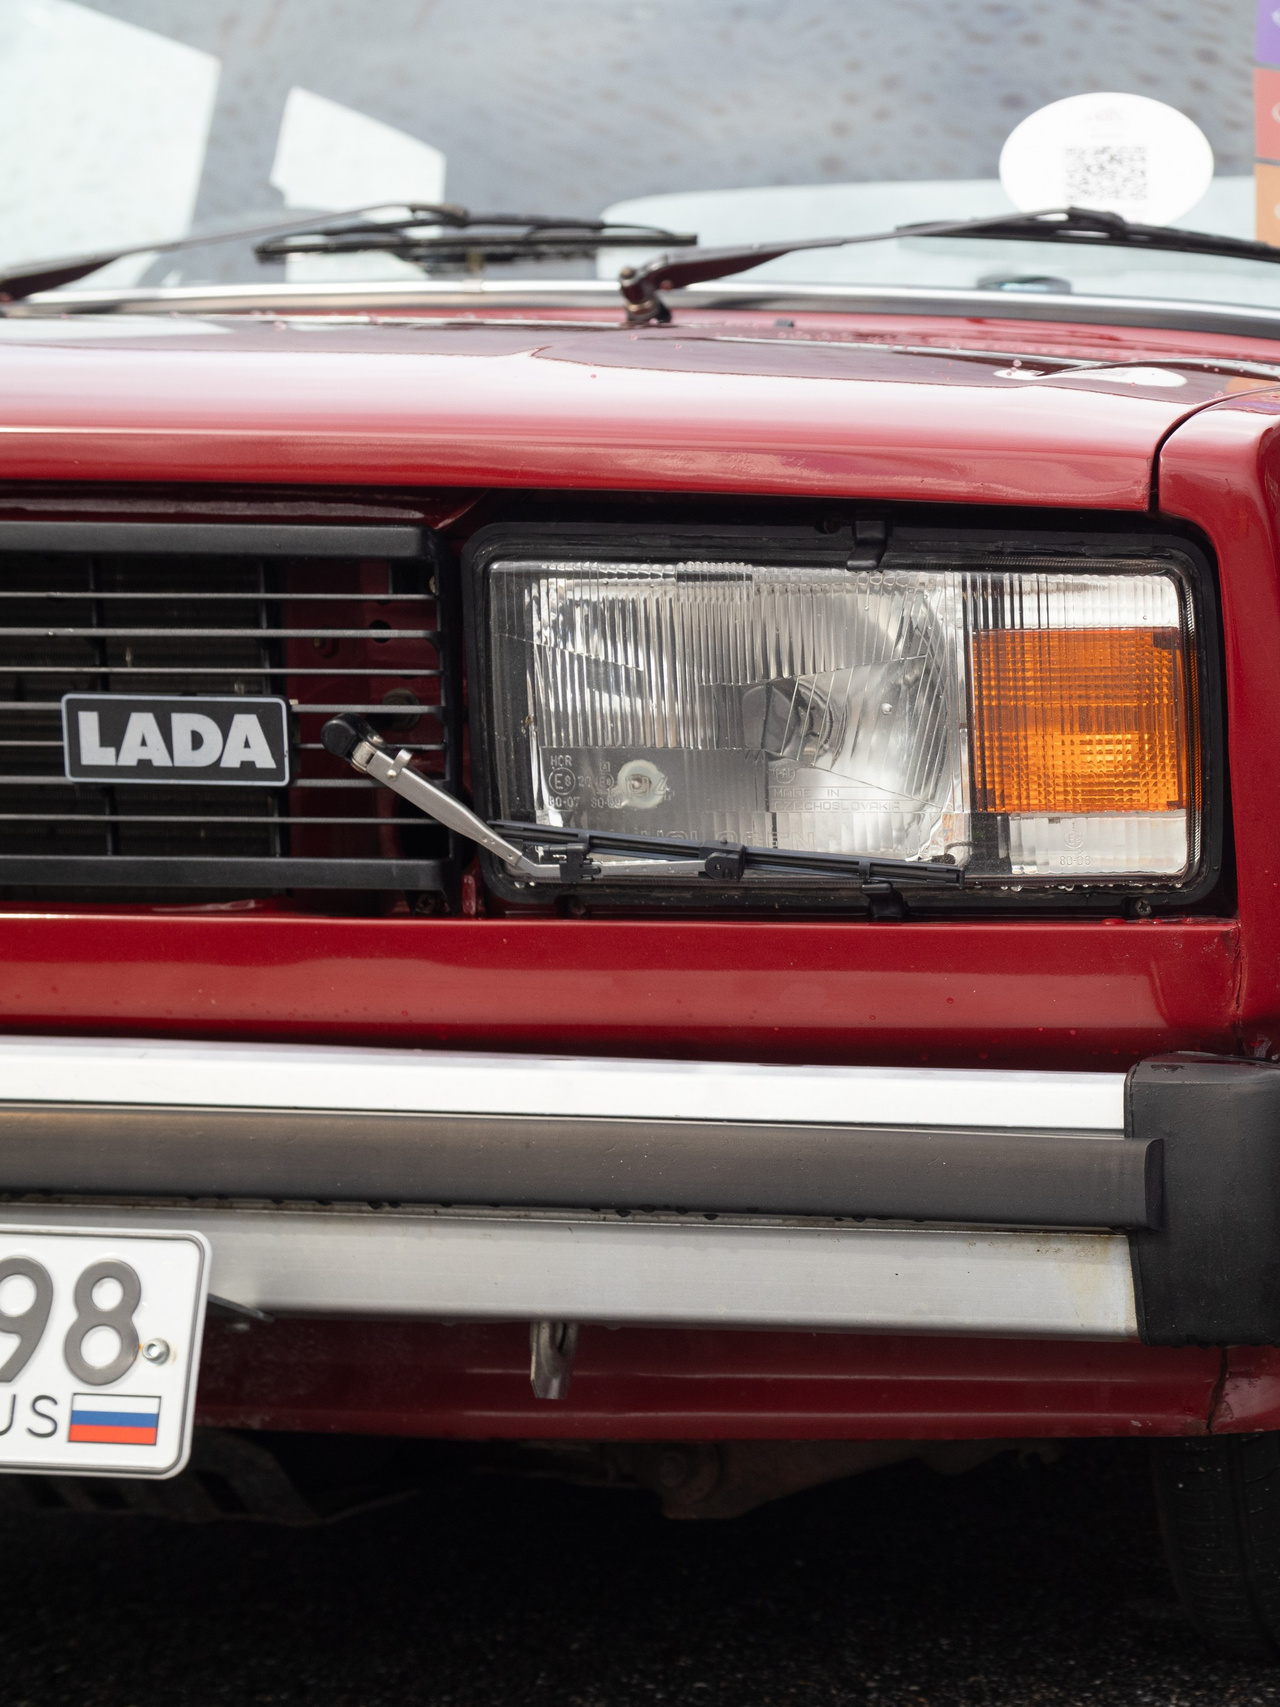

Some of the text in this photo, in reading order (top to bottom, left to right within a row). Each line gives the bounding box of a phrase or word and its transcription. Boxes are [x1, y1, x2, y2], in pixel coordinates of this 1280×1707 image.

[77, 710, 277, 769] LADA
[550, 754, 573, 767] HCR
[774, 788, 840, 798] MADE IN
[774, 801, 900, 811] CZECHOSLOVAKIA
